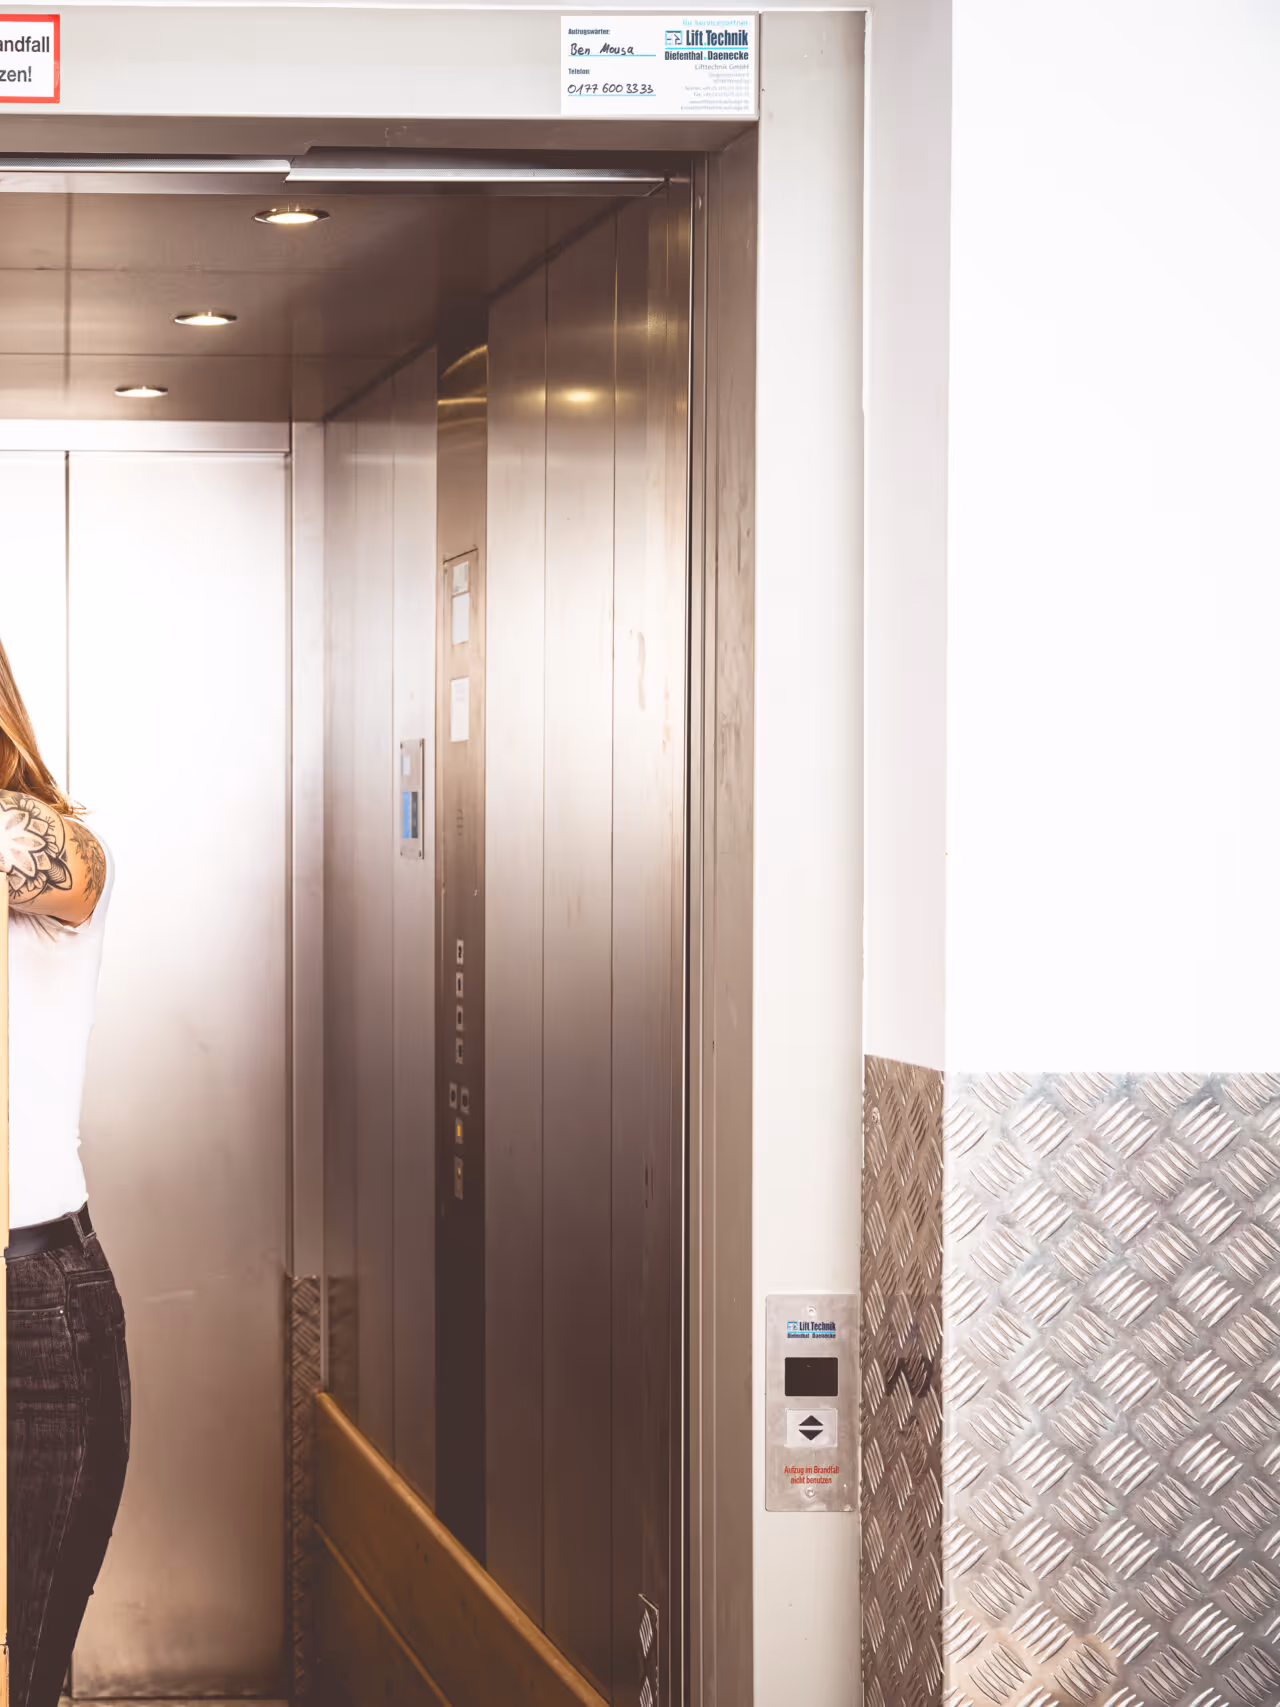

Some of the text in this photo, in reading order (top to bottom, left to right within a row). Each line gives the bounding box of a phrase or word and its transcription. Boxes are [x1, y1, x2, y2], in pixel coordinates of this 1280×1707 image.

[570, 42, 635, 56] Ben Mousa
[567, 84, 598, 95] 0177
[602, 83, 623, 94] 600
